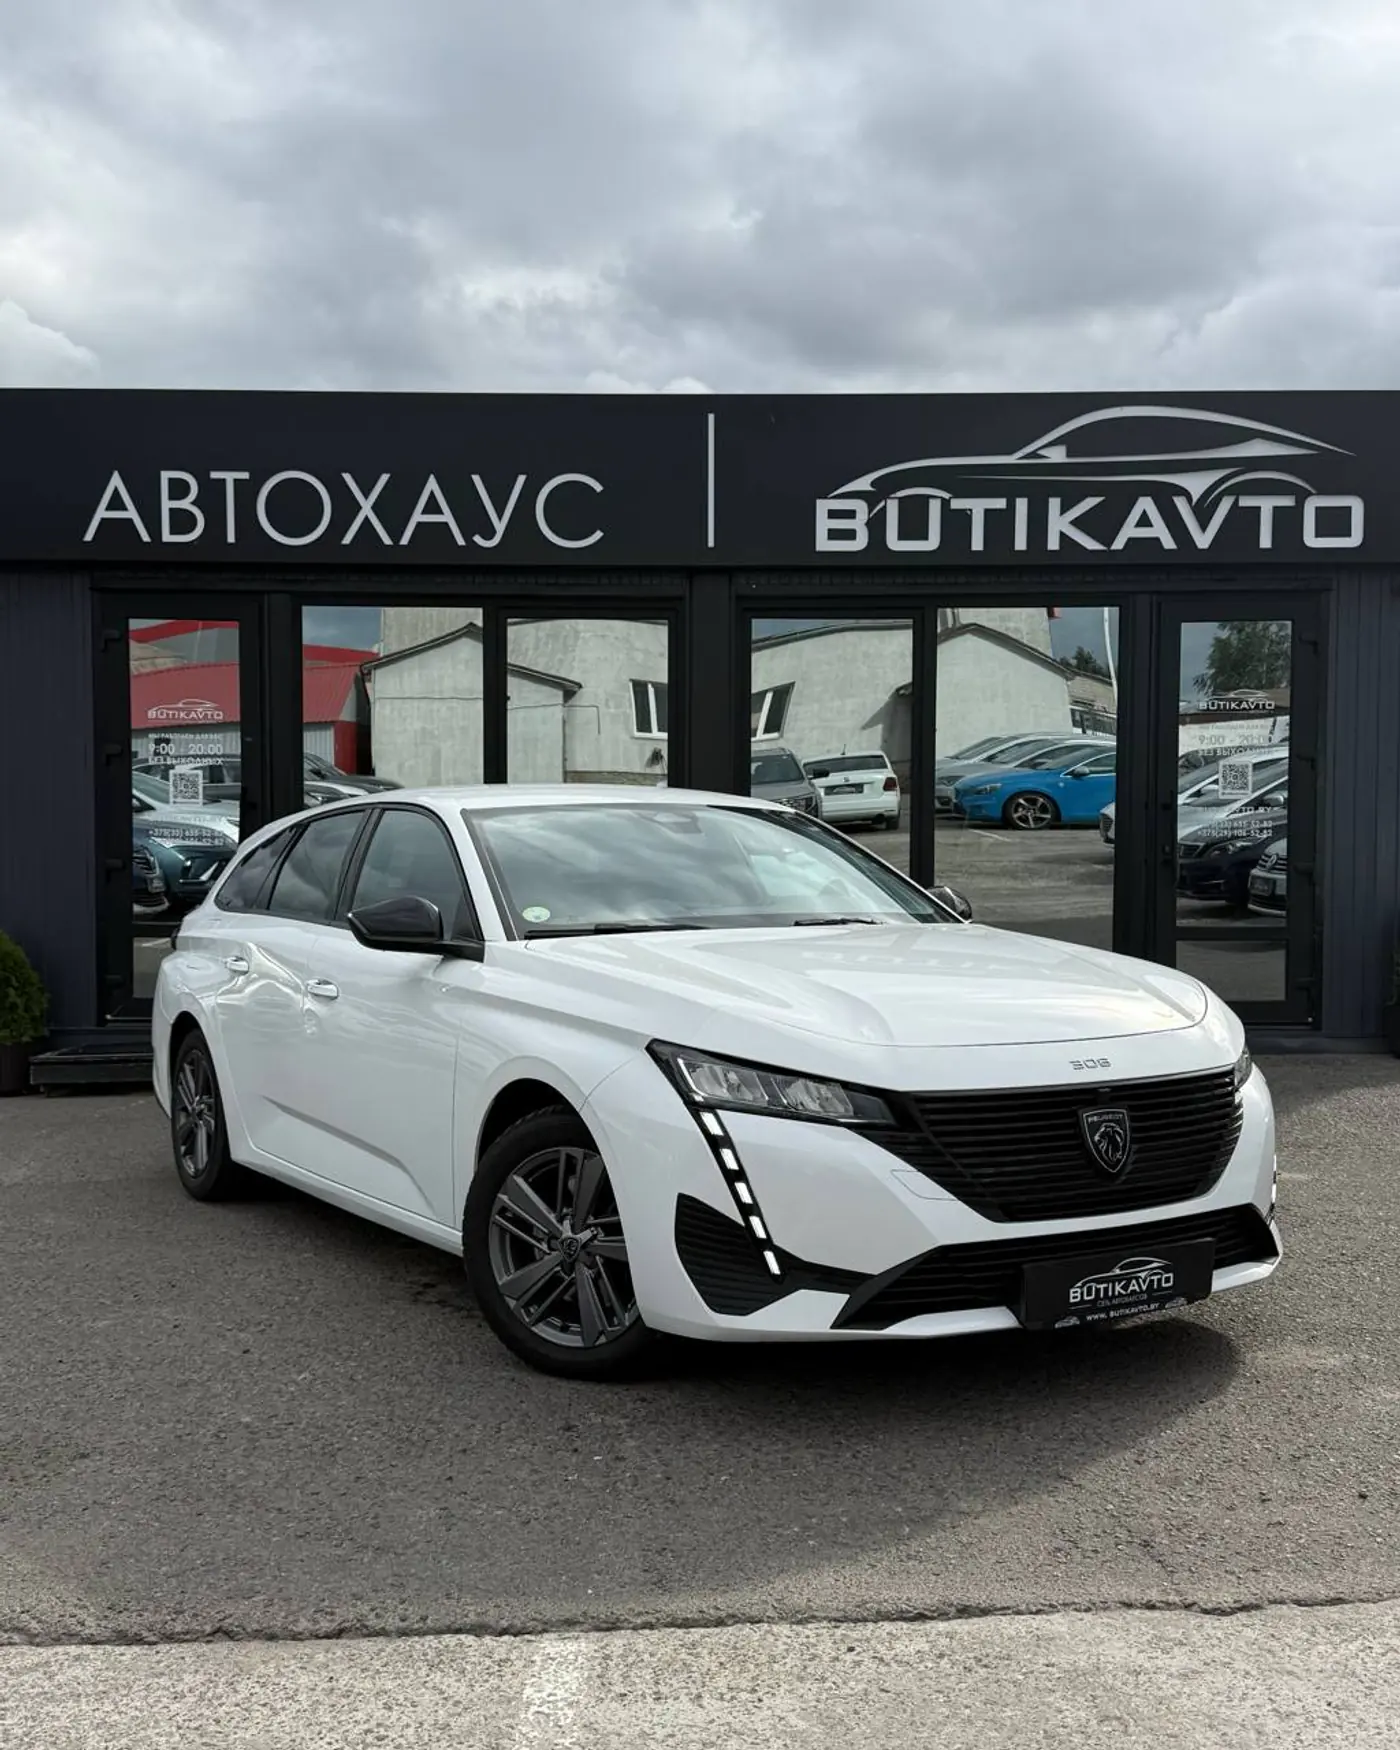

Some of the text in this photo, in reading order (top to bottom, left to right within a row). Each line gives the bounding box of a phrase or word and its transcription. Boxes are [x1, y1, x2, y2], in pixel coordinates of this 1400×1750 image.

[83, 470, 604, 549] АВТОХАУС
[815, 495, 1364, 553] BUTIKAVTO
[148, 710, 224, 720] BUTIKAVTO
[1199, 701, 1275, 710] BUTIKAVTO
[1069, 1272, 1174, 1303] BUTIKAVTO
